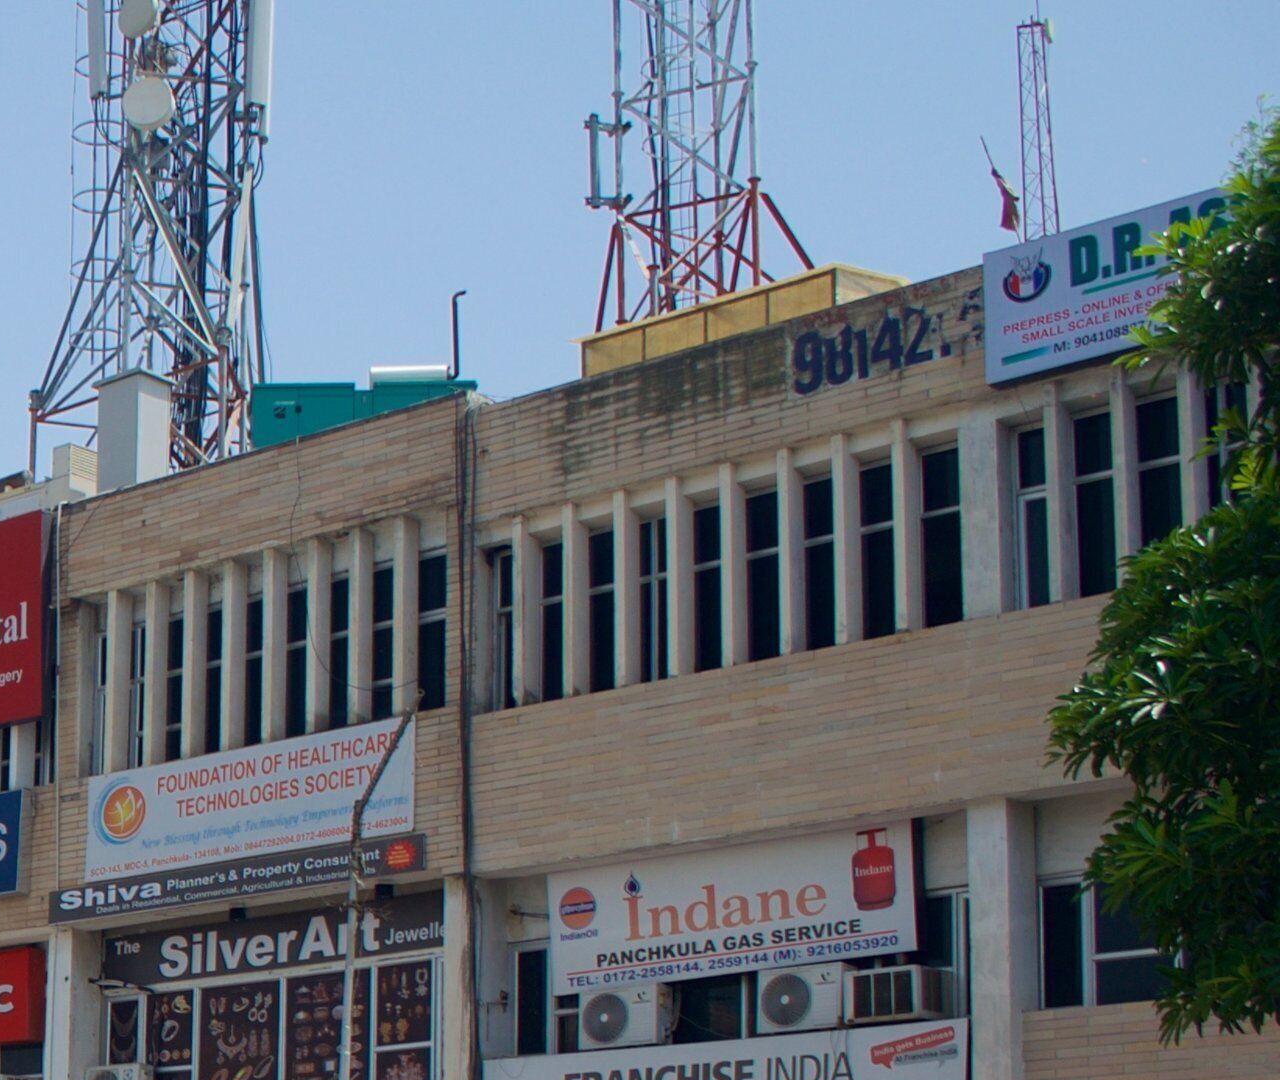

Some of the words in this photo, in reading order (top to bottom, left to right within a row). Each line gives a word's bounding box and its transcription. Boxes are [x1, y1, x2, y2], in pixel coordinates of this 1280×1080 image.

[1069, 222, 1155, 287] D.R.
[1002, 309, 1070, 335] PREPRESS
[1082, 294, 1129, 315] ONLINE
[1134, 290, 1142, 300] &
[1021, 326, 1064, 344] SMALL
[1067, 315, 1110, 331] SCALE
[1053, 341, 1071, 353] M:
[157, 761, 255, 796] FOUNDATION
[261, 753, 283, 777] OF
[176, 782, 299, 819] TECHNOLOGIES
[304, 762, 379, 797] SOCIETY
[59, 881, 162, 911] Shiva
[166, 870, 227, 892] Planner's
[229, 868, 238, 882] &
[243, 861, 299, 883] Property
[96, 904, 120, 914] Deals
[122, 902, 131, 910] in
[241, 876, 293, 893] Agricultural
[296, 875, 303, 884] &
[305, 870, 349, 883] Industrial
[854, 864, 893, 877] Indane
[623, 882, 827, 942] Indane
[114, 940, 140, 955] The
[560, 928, 598, 942] IndianOil
[596, 939, 716, 967] PANCHKULA
[723, 932, 764, 951] GAS
[771, 918, 862, 944] SERVICE
[567, 975, 599, 988] TEL:
[603, 962, 703, 983] 0172-2558144,
[708, 952, 768, 970] 2559144
[773, 948, 802, 964] (M):
[807, 934, 898, 957] 9216053920
[873, 1045, 895, 1057] India
[915, 1030, 953, 1046] Business
